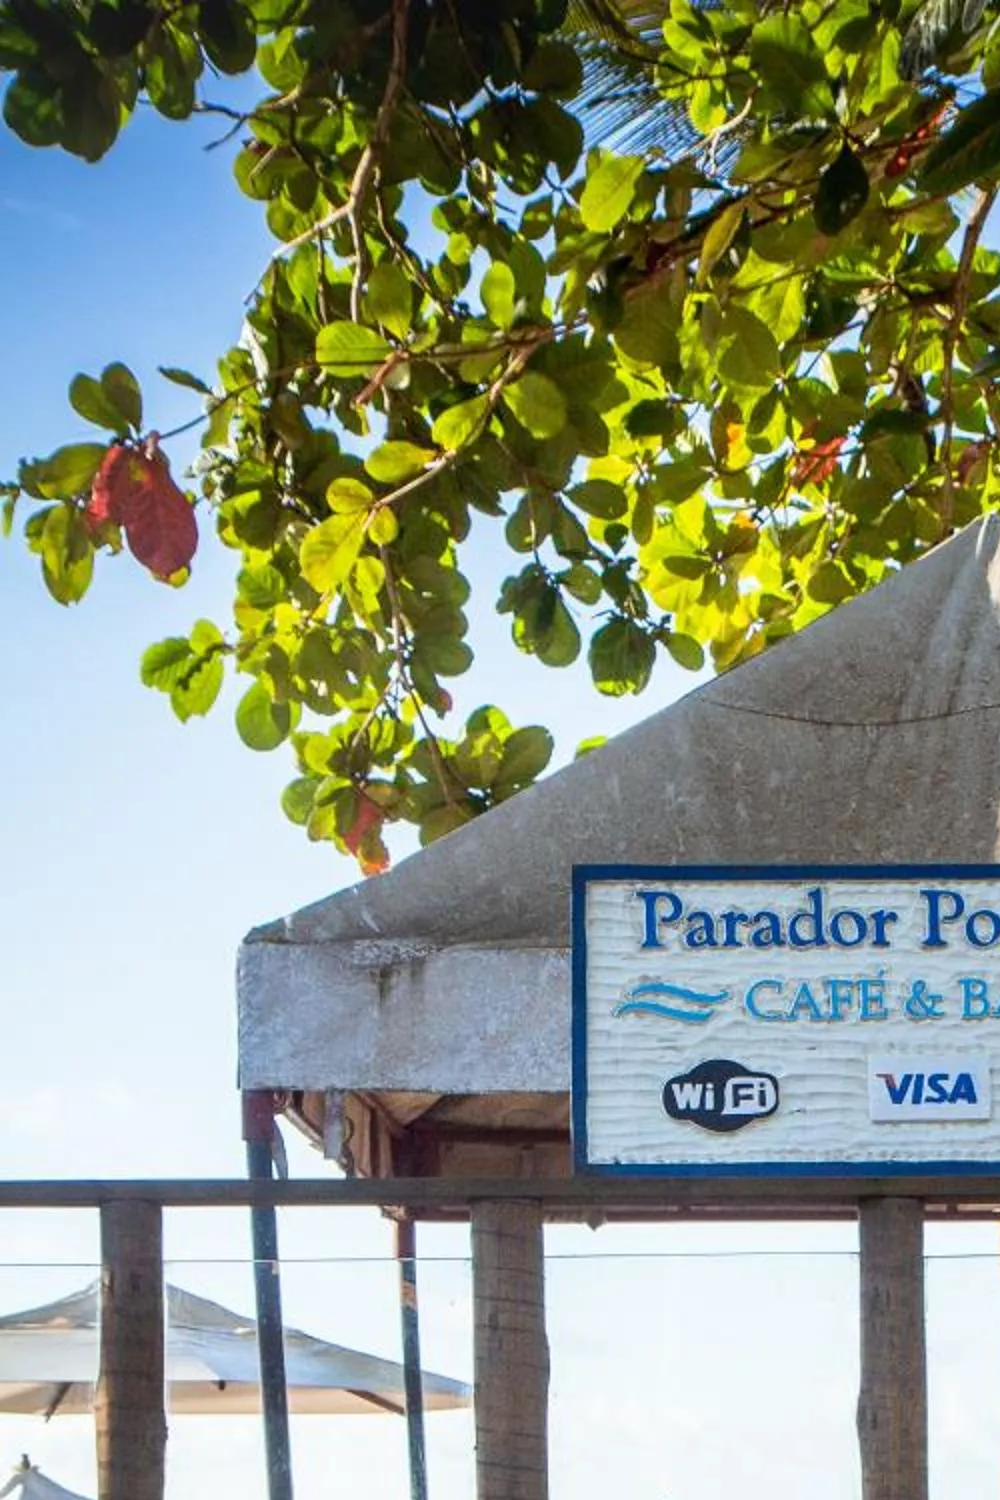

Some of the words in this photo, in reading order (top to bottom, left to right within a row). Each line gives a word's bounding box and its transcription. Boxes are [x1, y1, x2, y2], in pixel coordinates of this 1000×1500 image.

[636, 887, 898, 949] Parador
[744, 967, 891, 1022] CAFÉ
[904, 979, 946, 1021] &
[876, 1072, 978, 1106] VISA
